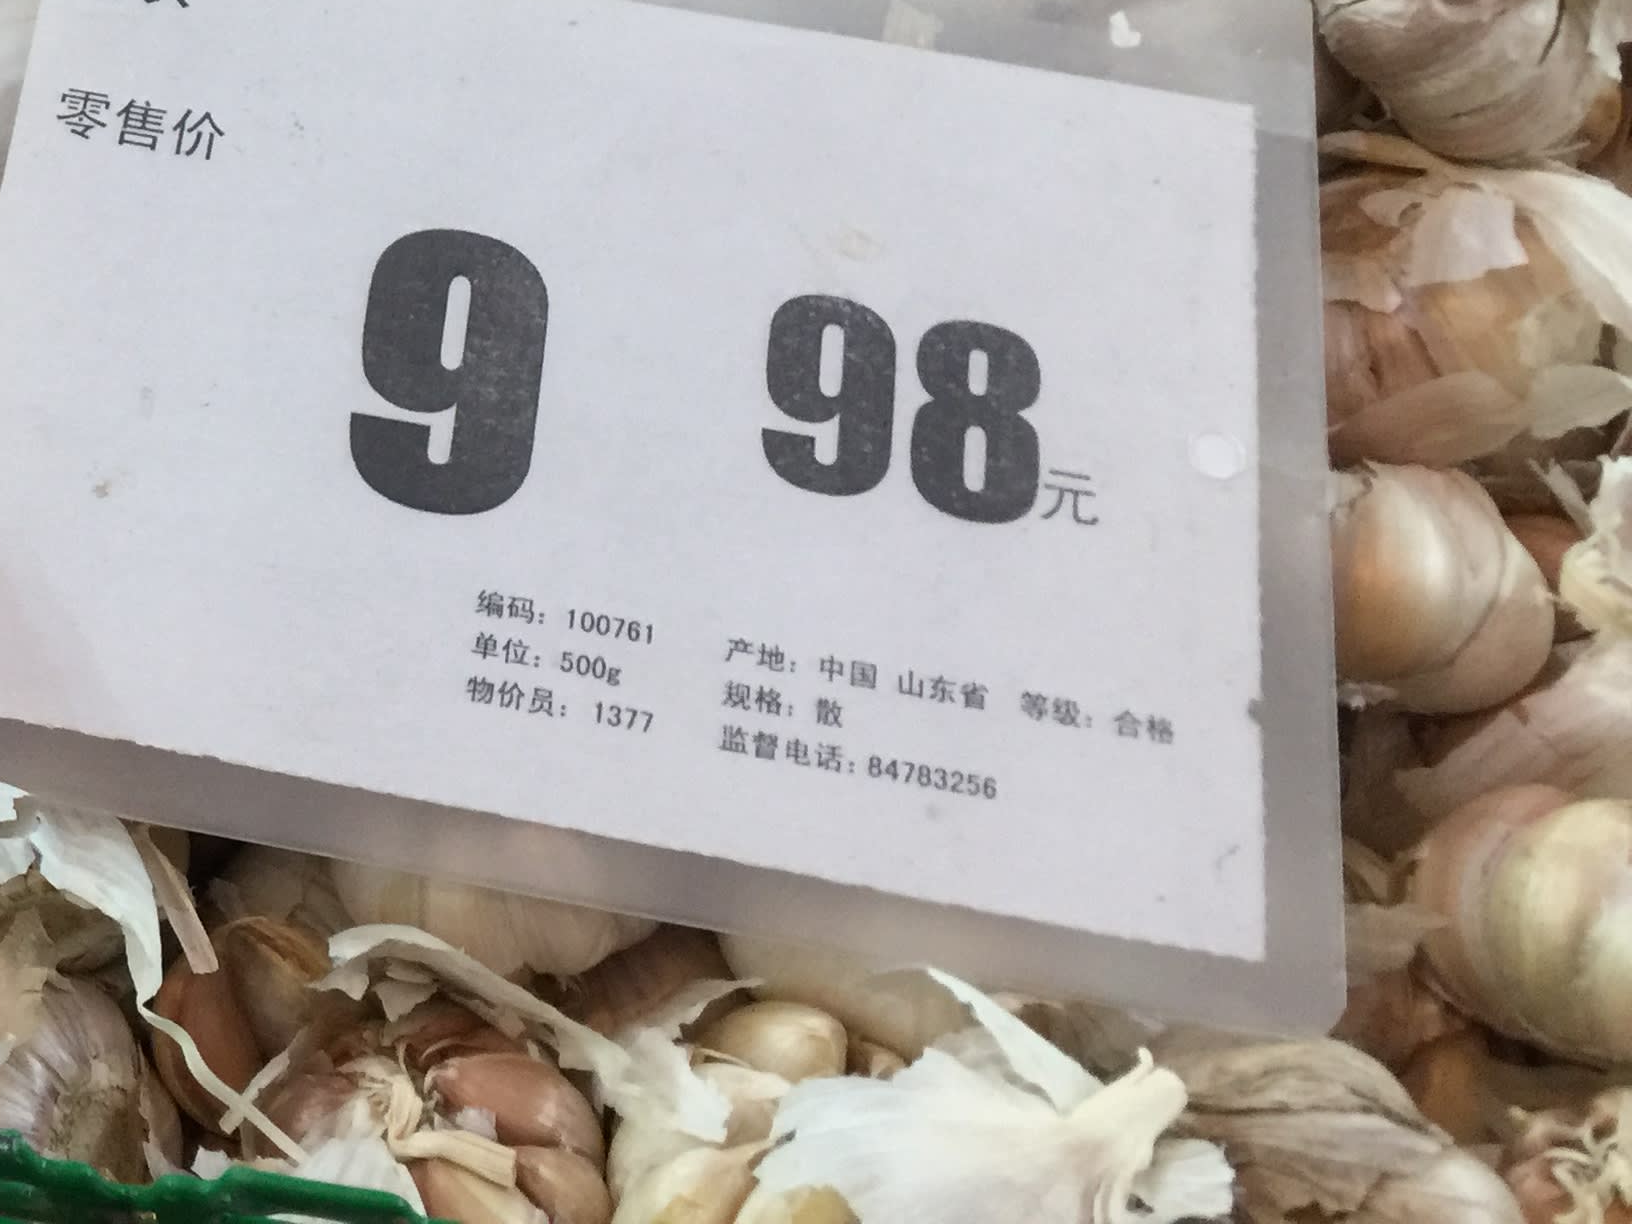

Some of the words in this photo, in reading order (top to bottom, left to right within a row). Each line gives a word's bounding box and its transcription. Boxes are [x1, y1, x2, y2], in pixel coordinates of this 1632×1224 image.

[56, 88, 225, 161] 零售价
[349, 228, 549, 516] 9
